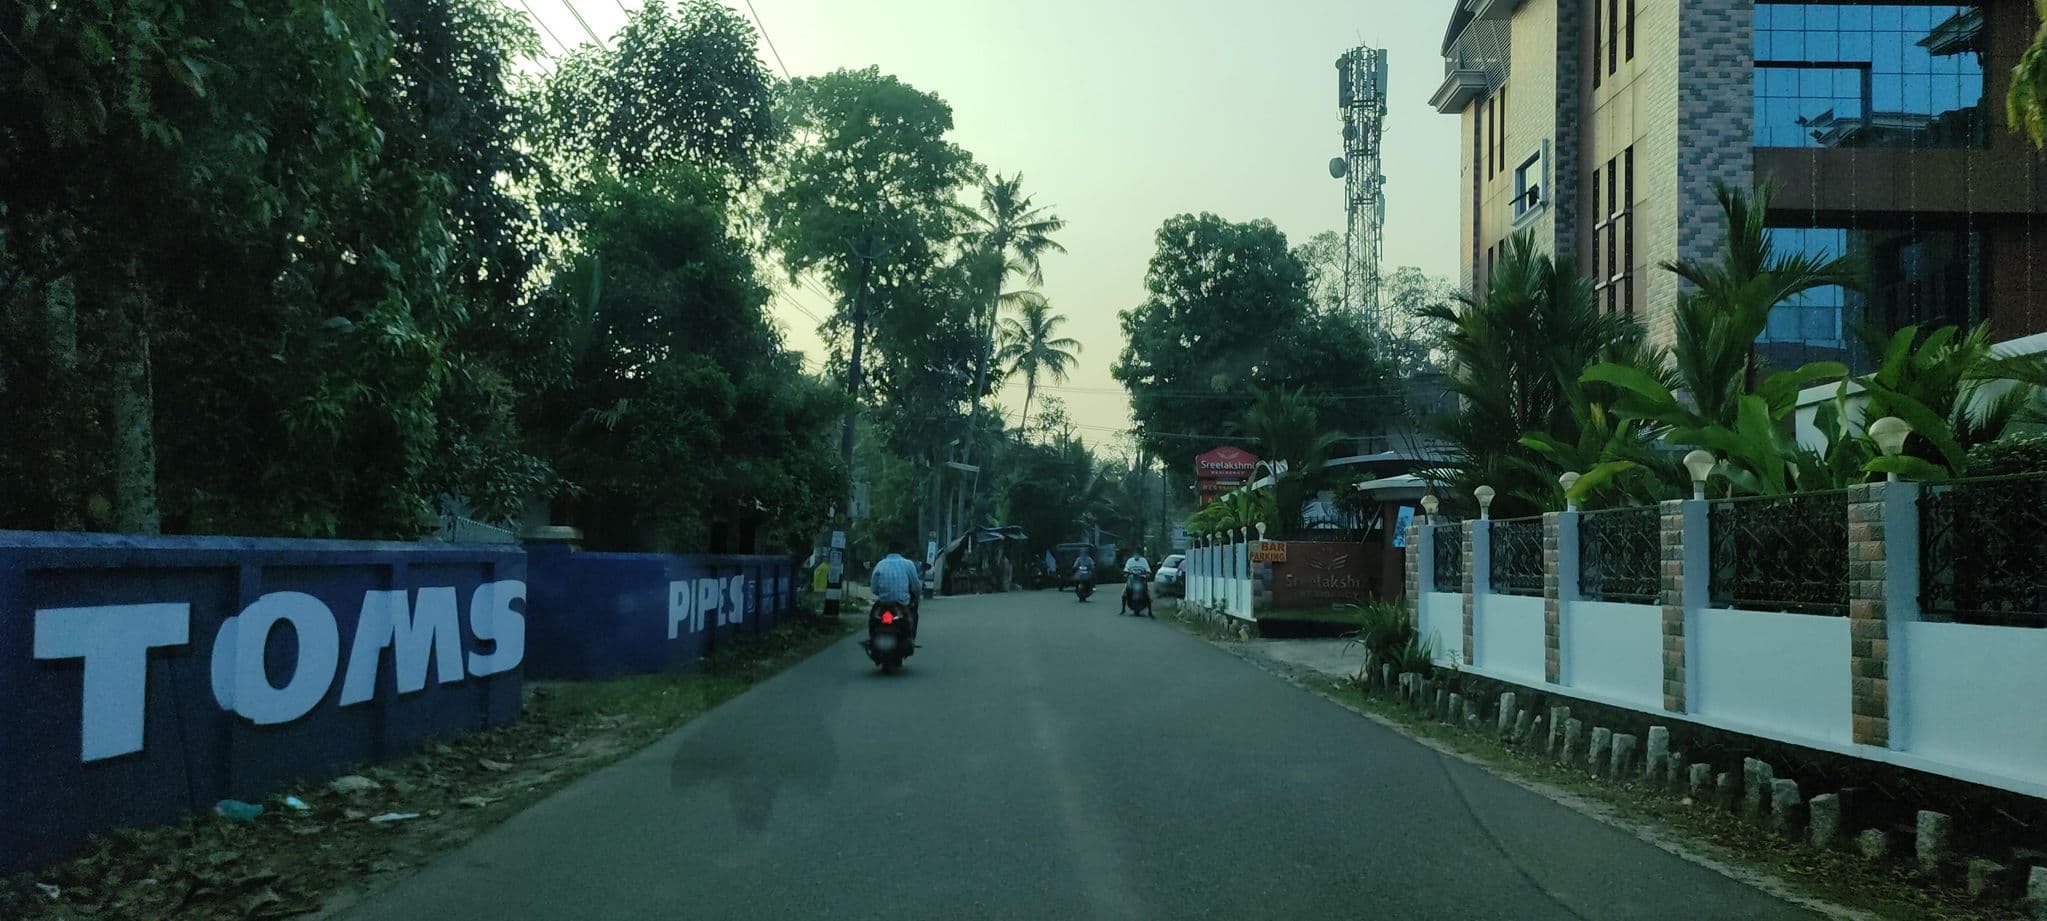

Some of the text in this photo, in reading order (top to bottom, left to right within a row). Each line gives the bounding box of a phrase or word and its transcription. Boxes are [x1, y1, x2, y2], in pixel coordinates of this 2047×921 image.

[1249, 552, 1285, 561] PARKING
[1261, 543, 1285, 551] BAR
[667, 574, 744, 640] PIPES
[34, 580, 526, 762] TOMS
